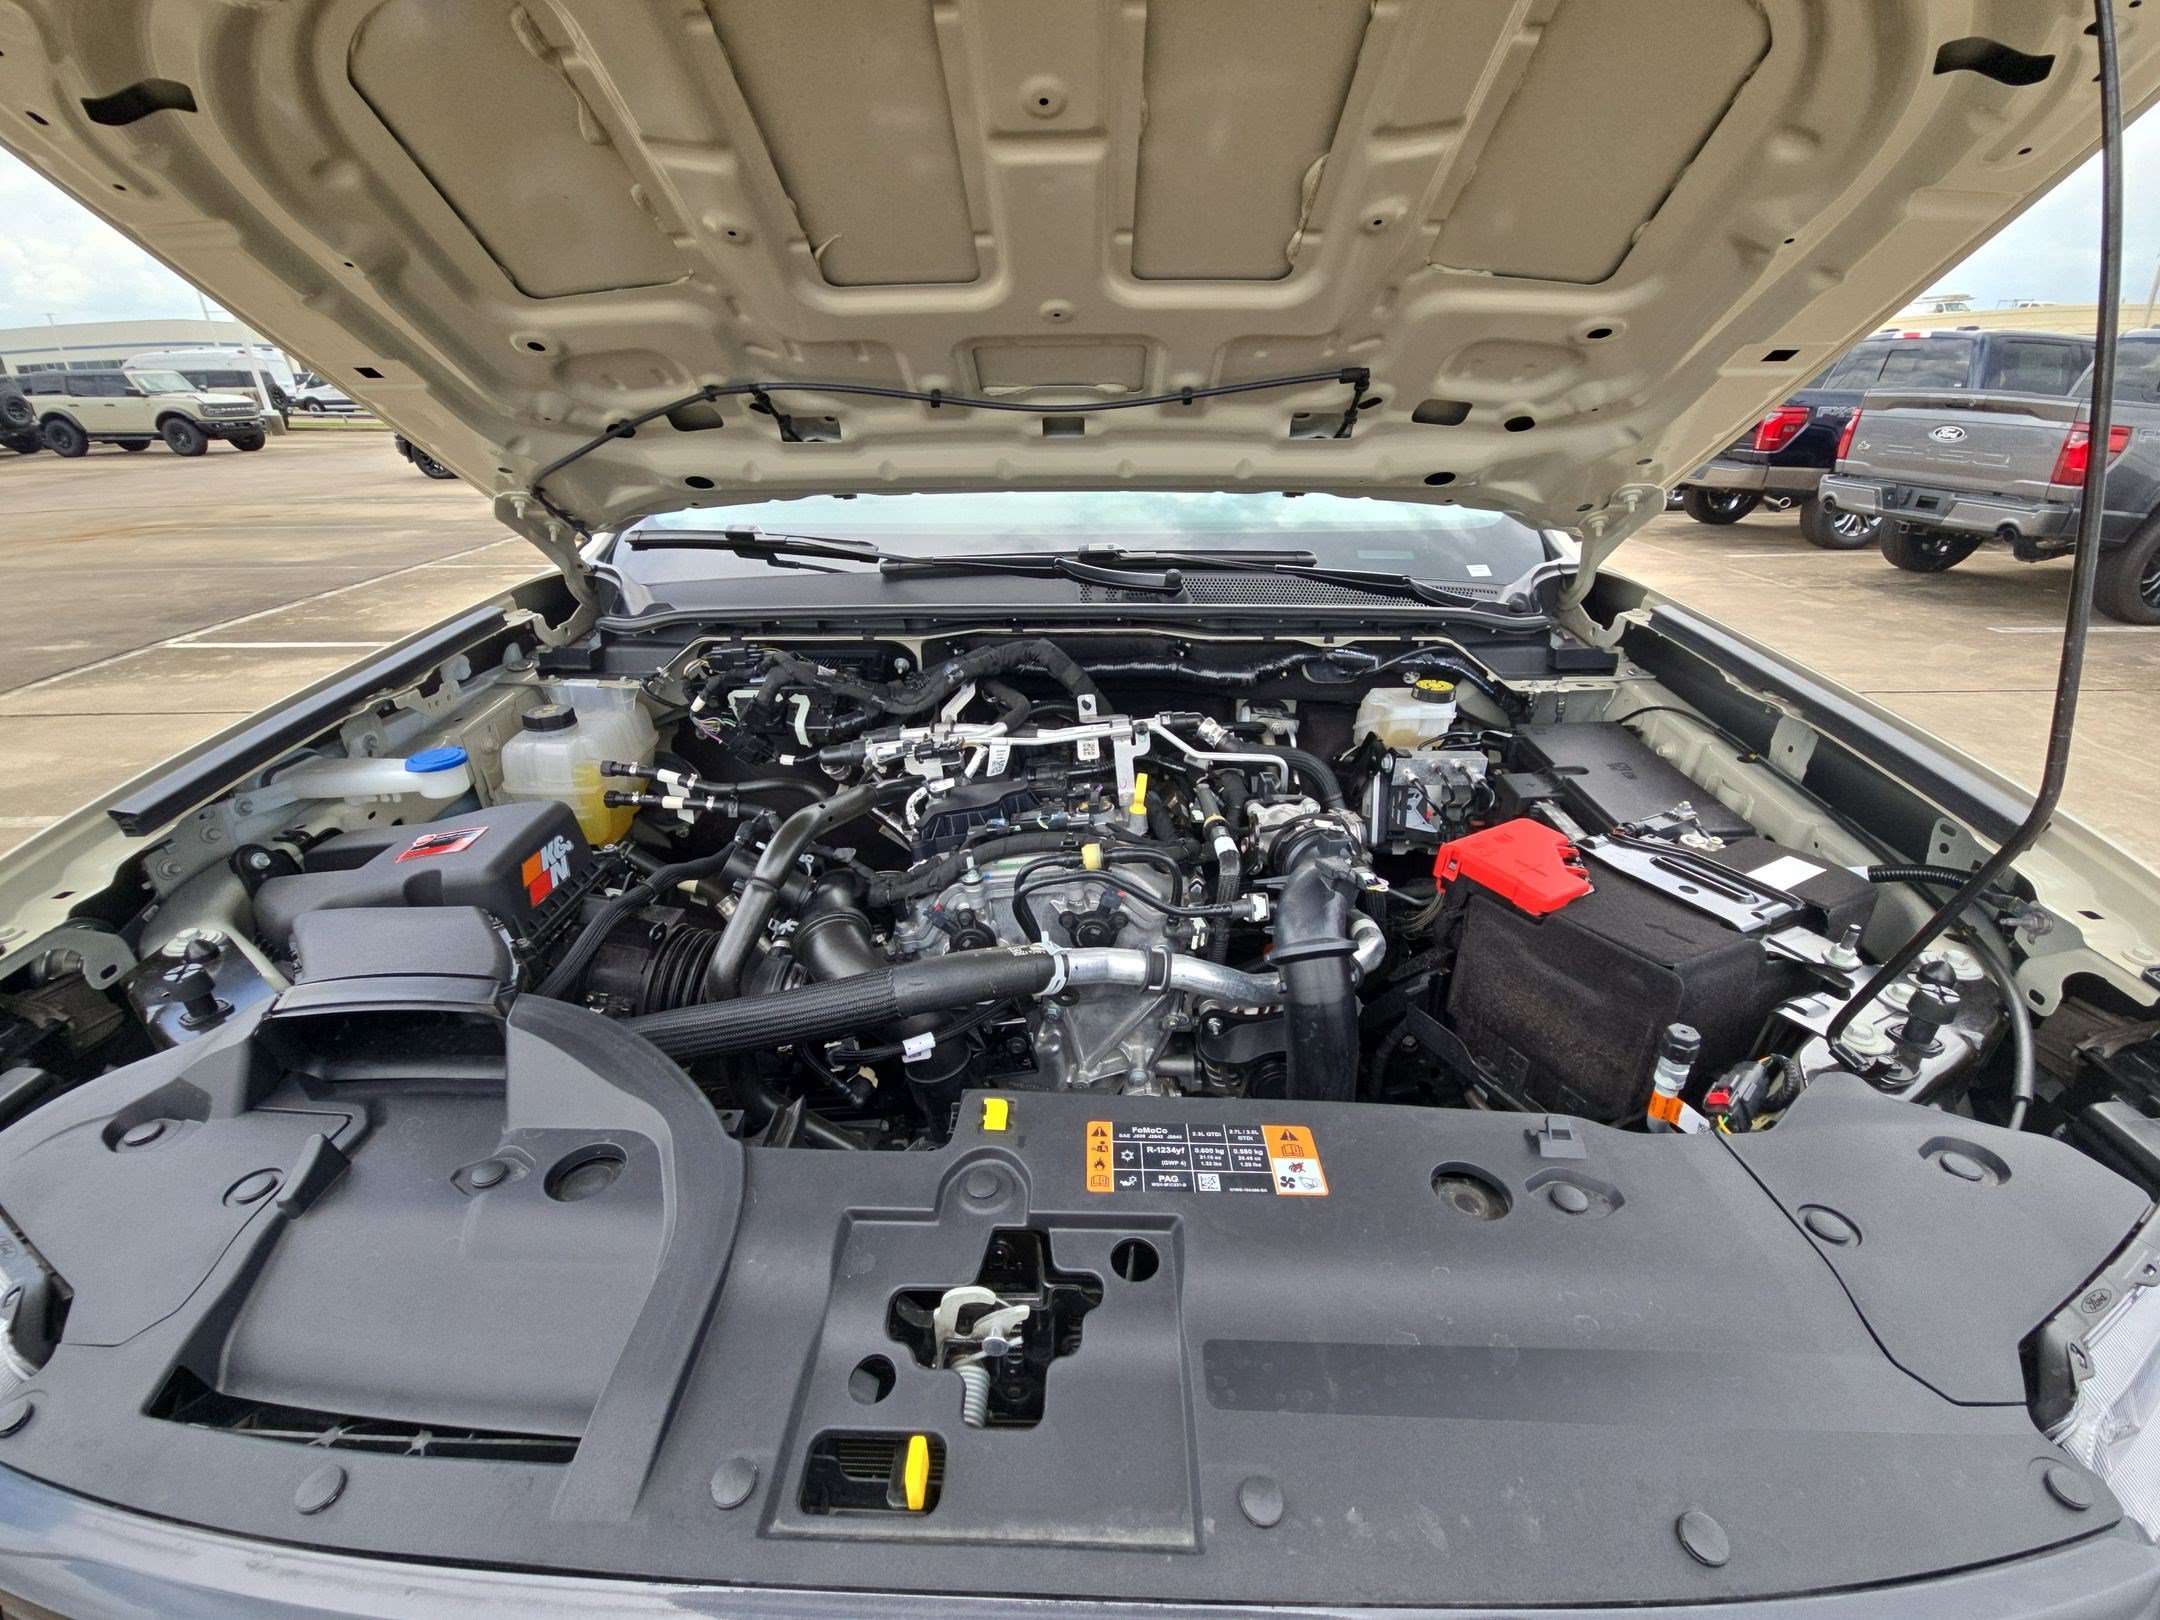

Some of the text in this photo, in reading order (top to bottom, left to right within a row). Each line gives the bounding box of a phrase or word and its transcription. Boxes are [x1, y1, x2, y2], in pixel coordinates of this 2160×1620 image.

[1936, 427, 1962, 439] Ford
[1131, 1126, 1168, 1134] FoMoCo
[1146, 1146, 1185, 1155] R-1234yf
[1158, 1175, 1179, 1183] PAG
[2085, 1292, 2108, 1311] Ford
